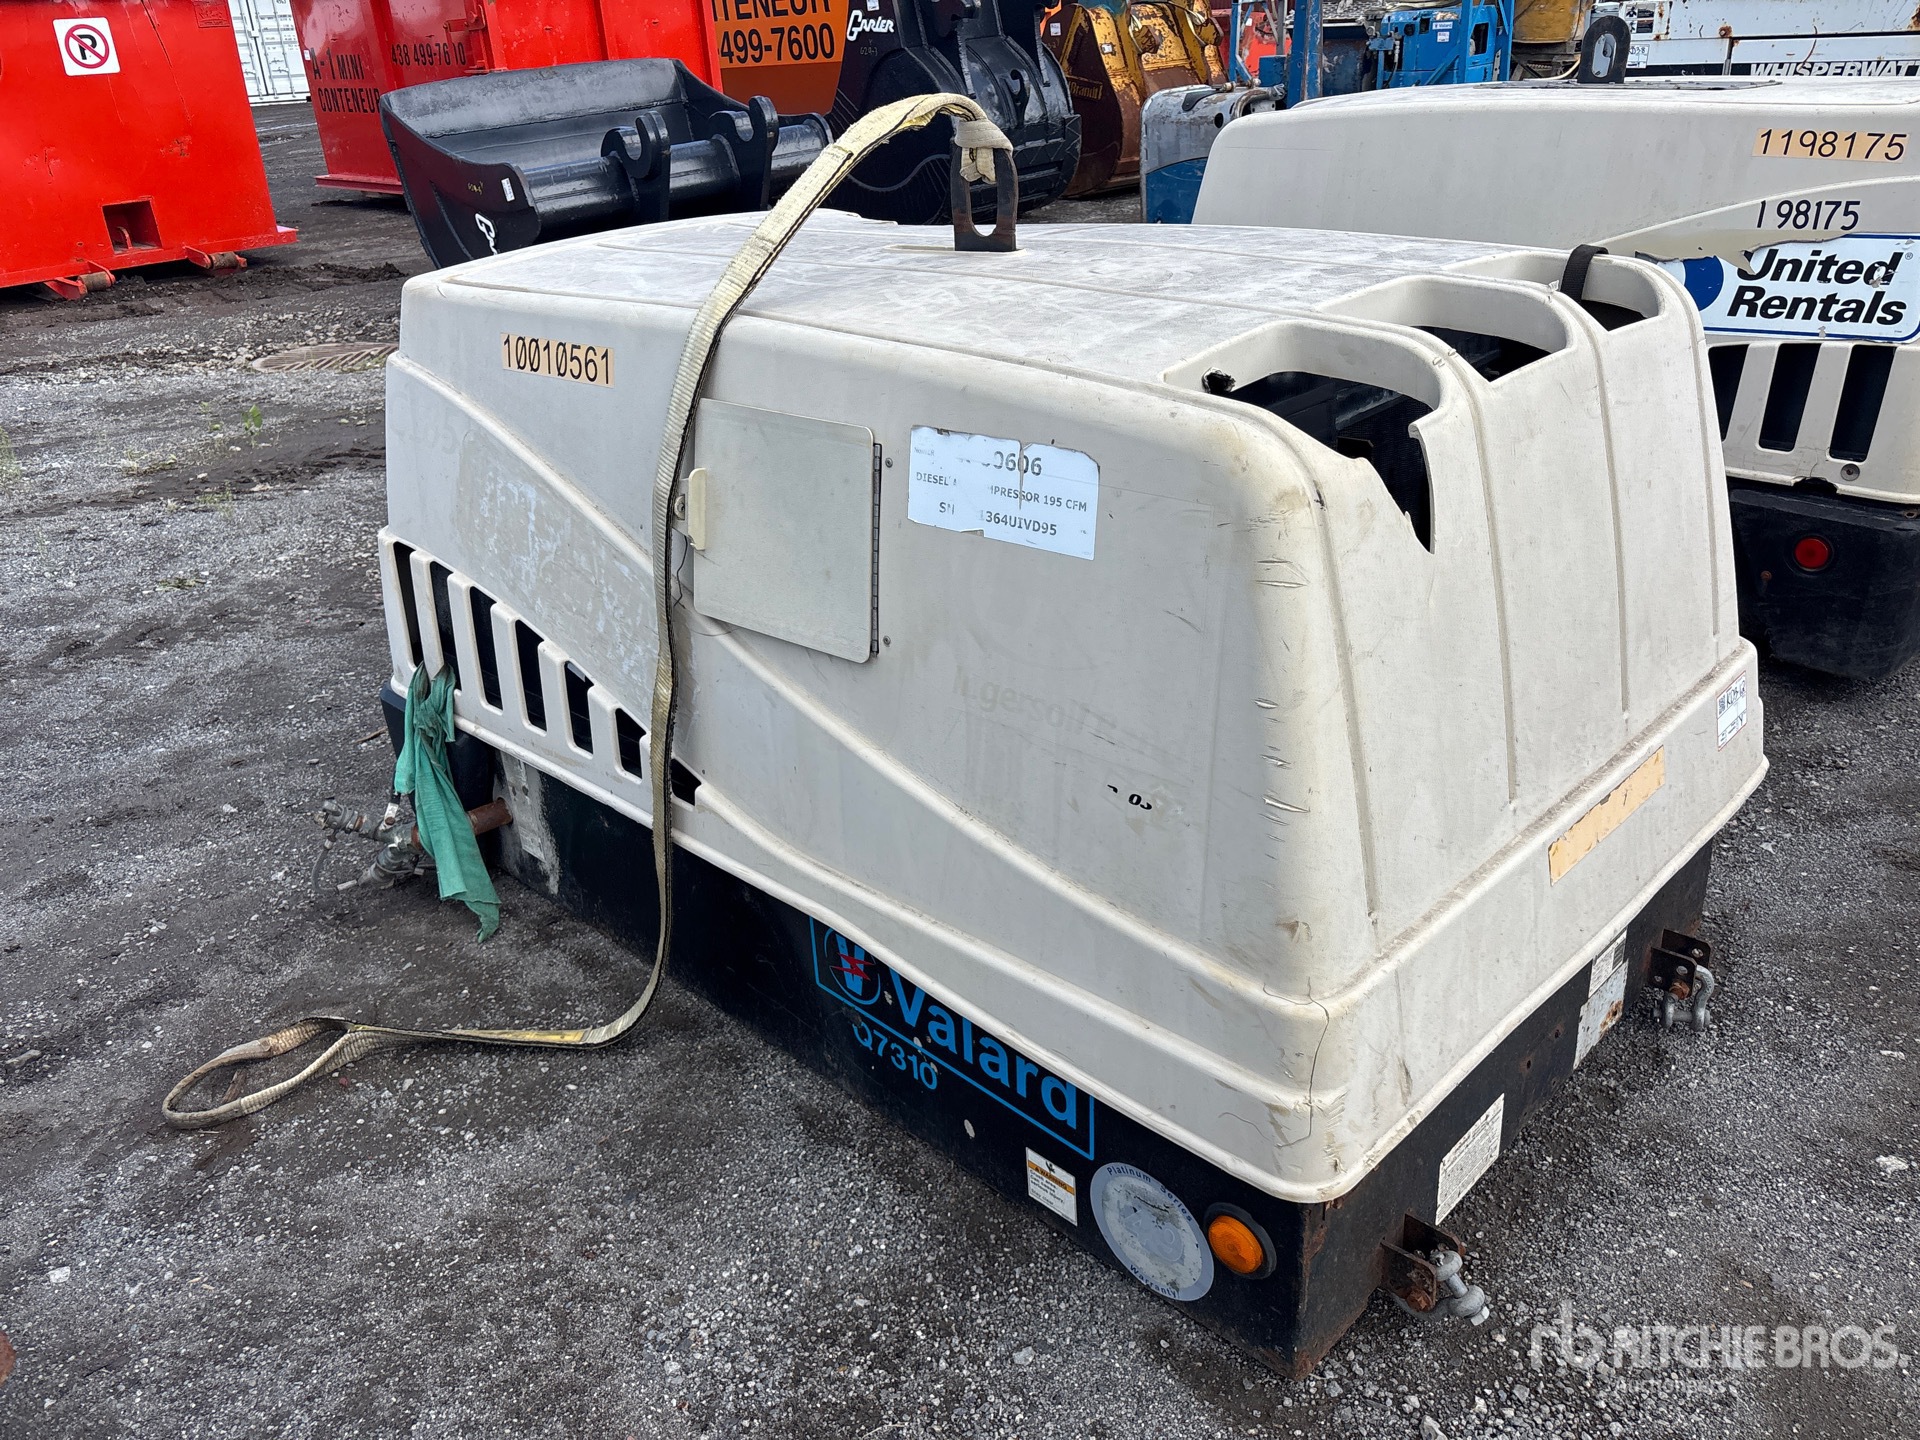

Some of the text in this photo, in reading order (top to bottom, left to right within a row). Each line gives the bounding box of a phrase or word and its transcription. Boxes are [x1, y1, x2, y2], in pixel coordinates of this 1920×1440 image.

[336, 54, 365, 80] MINI
[391, 44, 411, 66] 438
[1760, 128, 1908, 161] 1198175
[1737, 248, 1904, 286] United
[1726, 285, 1907, 326] Rentals
[503, 333, 609, 385] 10010561
[1043, 494, 1063, 508] 195
[1065, 498, 1088, 513] CFM
[852, 1021, 938, 1090] Q7310
[888, 966, 1078, 1130] Valard
[1107, 1166, 1193, 1222] Platinum Series
